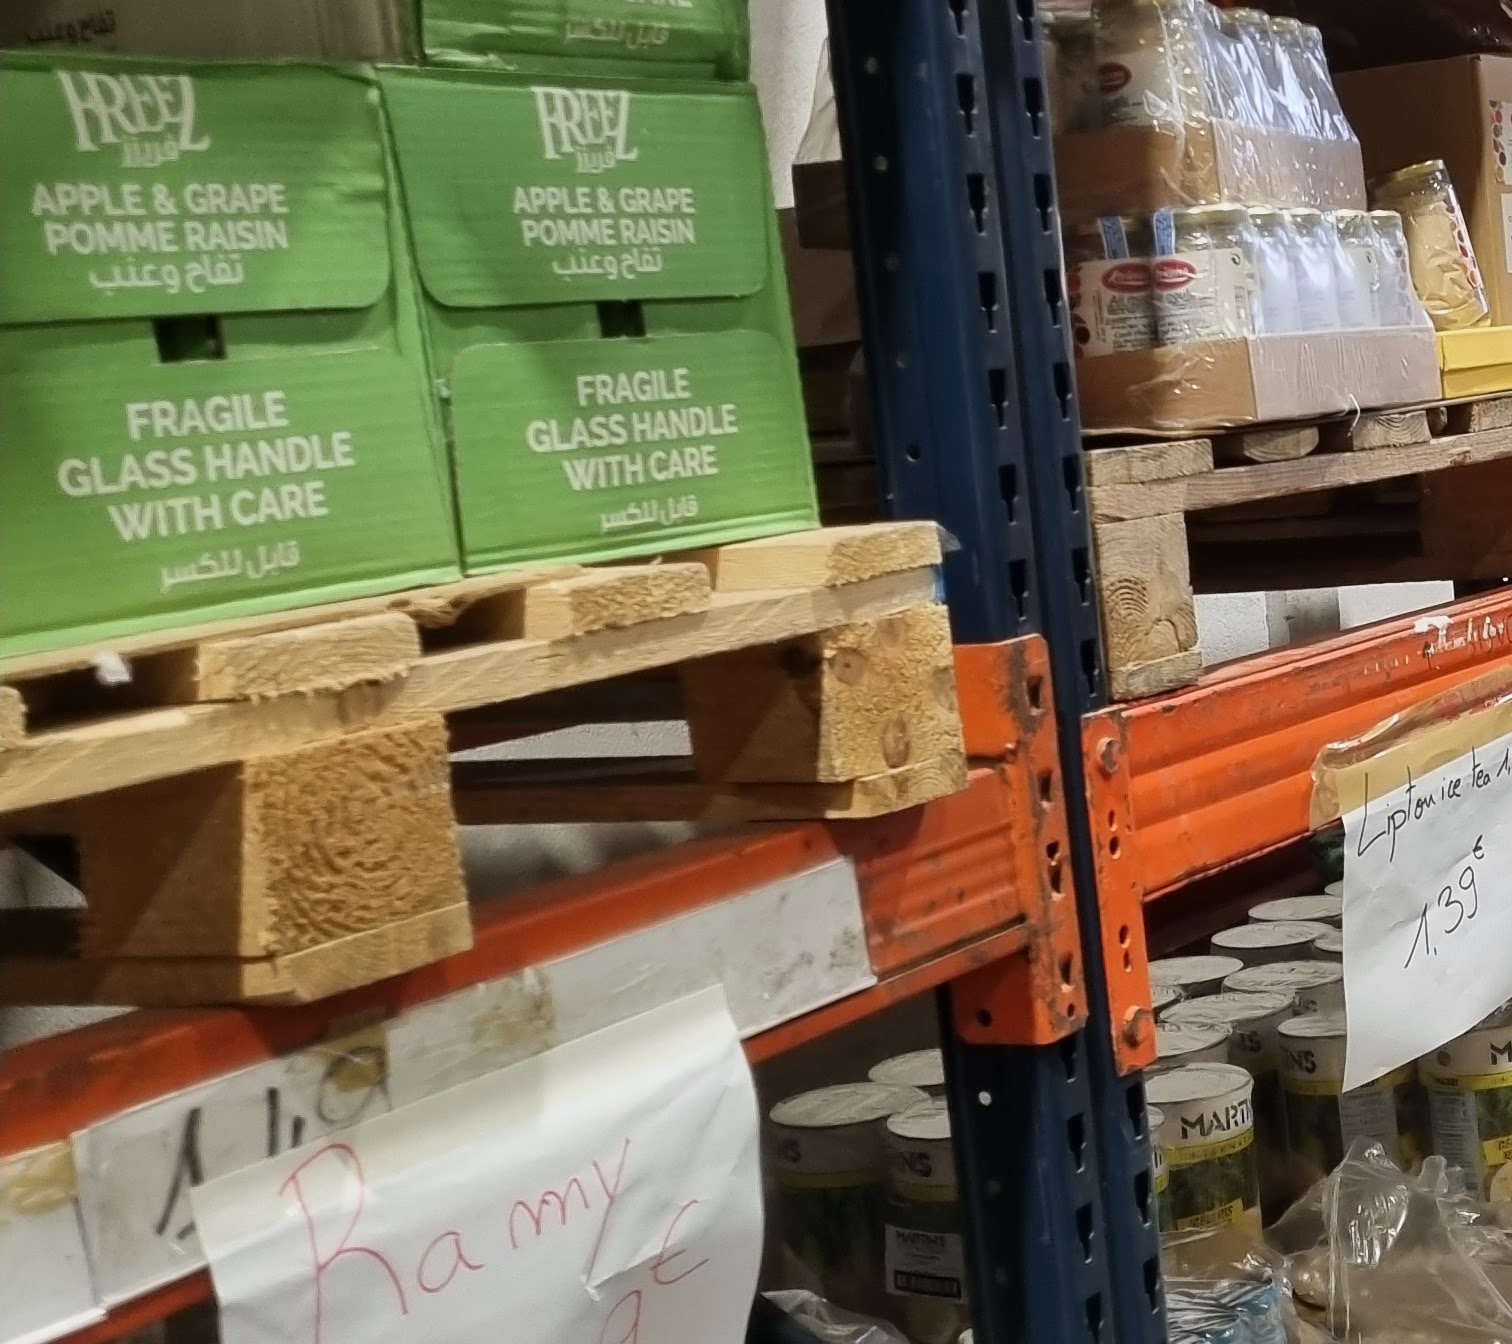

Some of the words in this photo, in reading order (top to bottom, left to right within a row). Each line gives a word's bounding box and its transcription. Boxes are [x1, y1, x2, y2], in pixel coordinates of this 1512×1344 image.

[31, 182, 147, 217] APPLE
[151, 182, 180, 216] &
[183, 182, 291, 215] GRAPE
[512, 185, 594, 215] APPLE
[596, 185, 617, 214] &
[618, 186, 697, 214] GRAPE
[43, 220, 180, 256] POMME
[183, 219, 290, 252] RAISIN
[520, 218, 619, 248] POMME
[619, 217, 697, 245] RAISIN
[575, 366, 692, 407] FRAGILE
[125, 390, 291, 442] FRAGILE
[525, 412, 629, 454] GLASS
[632, 403, 740, 443] HANDLE
[56, 447, 199, 498] GLASS
[203, 431, 357, 483] HANDLE
[560, 453, 646, 492] WITH
[650, 444, 720, 482] CARE
[107, 493, 224, 543] WITH
[230, 479, 330, 527] CARE
[1440, 773, 1462, 803] ice
[1471, 745, 1492, 789] tea
